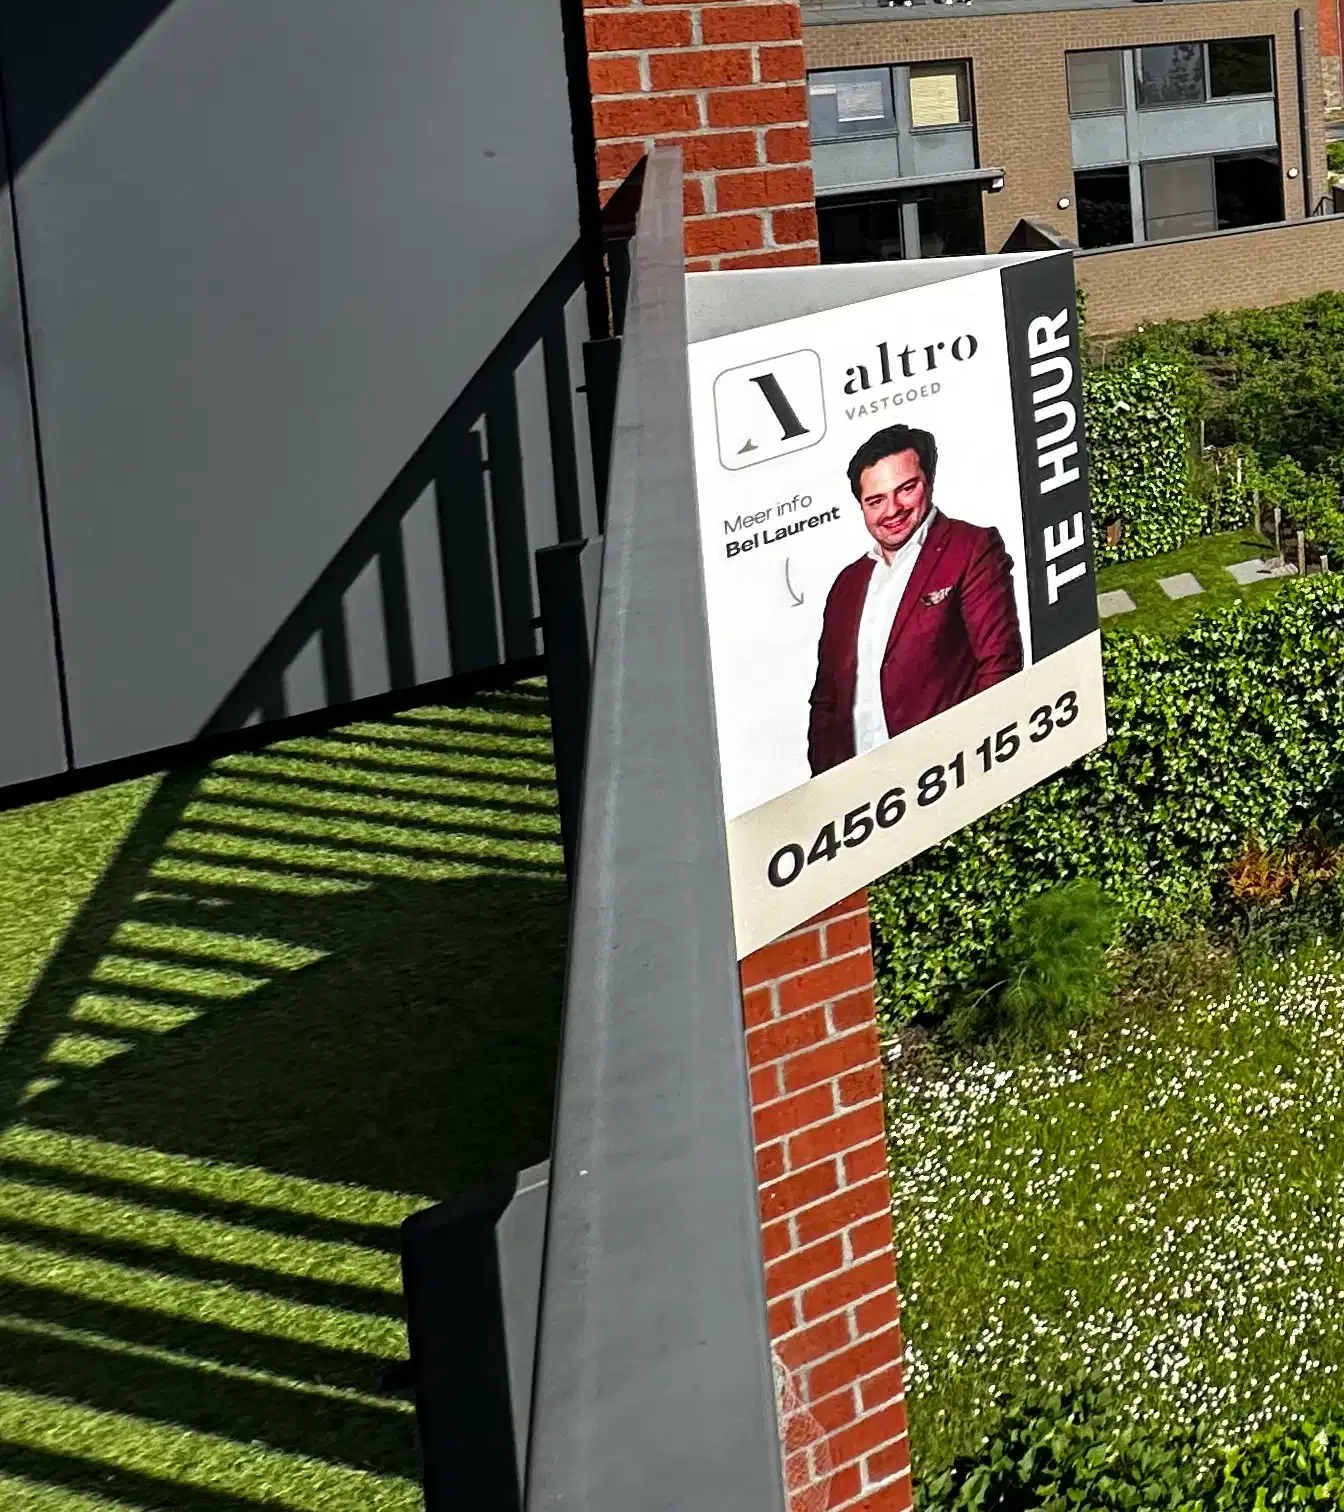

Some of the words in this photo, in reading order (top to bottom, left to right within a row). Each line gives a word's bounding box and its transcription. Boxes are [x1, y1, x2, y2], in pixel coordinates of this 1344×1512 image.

[844, 334, 978, 395] altro
[845, 382, 941, 420] VASTGOED
[1027, 308, 1080, 495] HUUR
[724, 506, 772, 535] Meer
[777, 493, 813, 516] info
[725, 533, 759, 559] Bel
[763, 506, 841, 545] Laurent
[1043, 511, 1087, 605] TE
[767, 787, 906, 888] 0456
[917, 751, 964, 807] 81
[976, 721, 1021, 773] 15
[1029, 691, 1079, 743] 33
